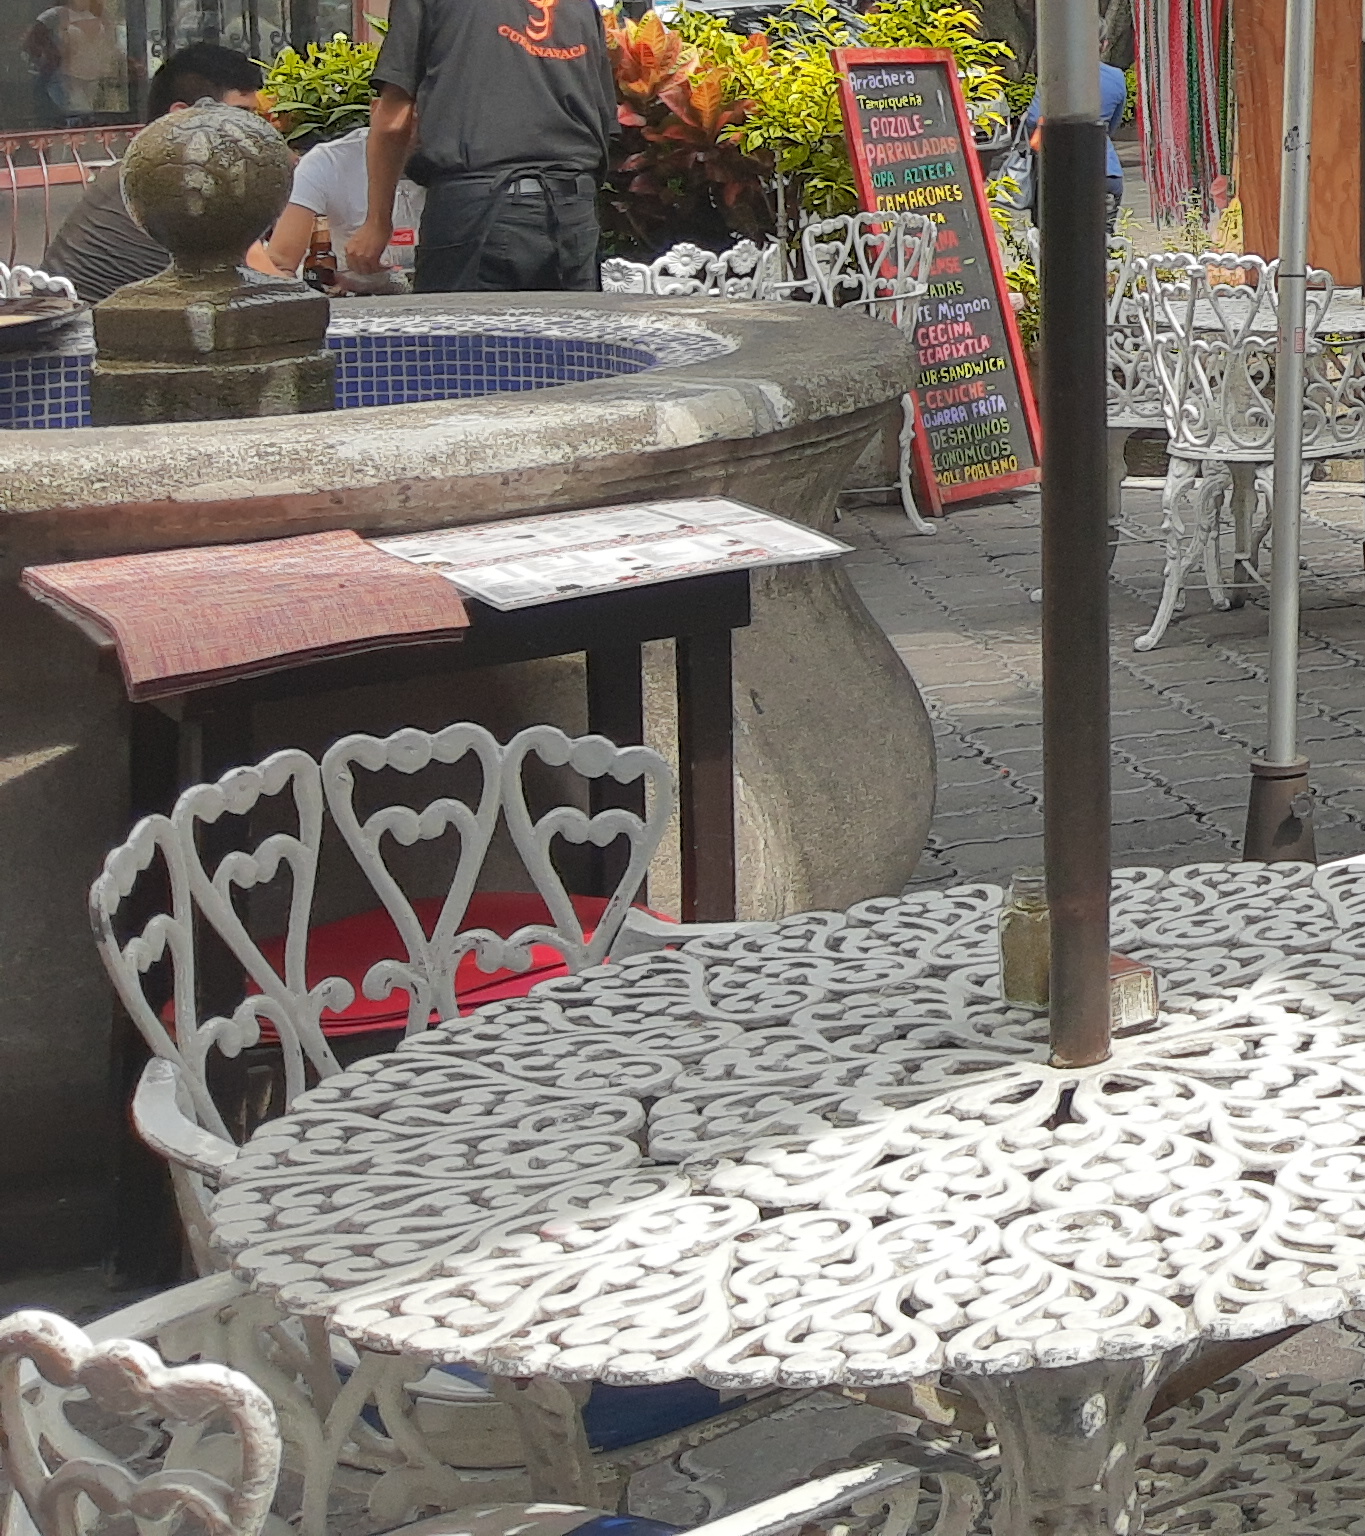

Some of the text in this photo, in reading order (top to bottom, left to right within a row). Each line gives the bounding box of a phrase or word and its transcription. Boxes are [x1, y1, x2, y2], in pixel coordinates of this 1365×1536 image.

[848, 69, 915, 91] Arrachera
[856, 92, 923, 112] Tampiqueña
[865, 136, 959, 167] PARRILLADAS
[904, 161, 955, 184] AZTECA
[876, 184, 963, 212] CAMARONES
[938, 297, 991, 322] Mignon
[916, 334, 991, 365] ECAPIXTLA
[930, 417, 1011, 450] DESAYUNOS
[964, 454, 1018, 483] POBLANO
